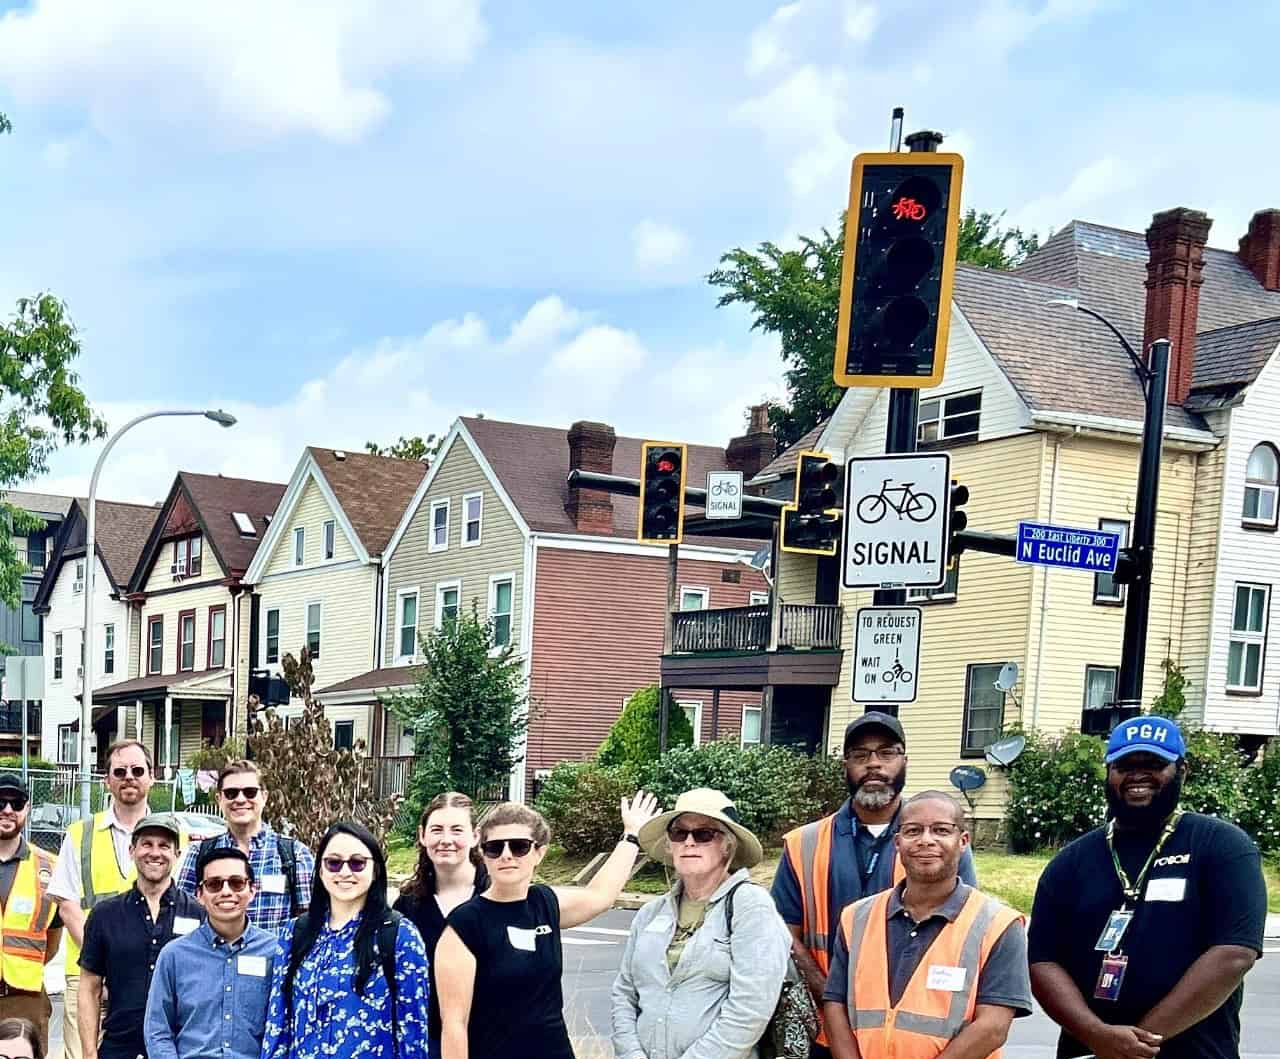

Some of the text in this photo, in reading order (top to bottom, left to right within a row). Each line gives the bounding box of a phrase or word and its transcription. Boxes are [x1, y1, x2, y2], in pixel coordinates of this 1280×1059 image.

[710, 501, 736, 510] SIGNAL
[1049, 530, 1064, 543] East
[1065, 533, 1091, 546] Liberty
[852, 541, 937, 566] SIGNAL
[1023, 541, 1111, 567] N Euclid Ave
[863, 616, 916, 628] TO REQUEST
[873, 633, 902, 645] GREEN
[861, 656, 881, 668] WAIT
[864, 673, 877, 684] ON
[1126, 724, 1168, 743] PGH
